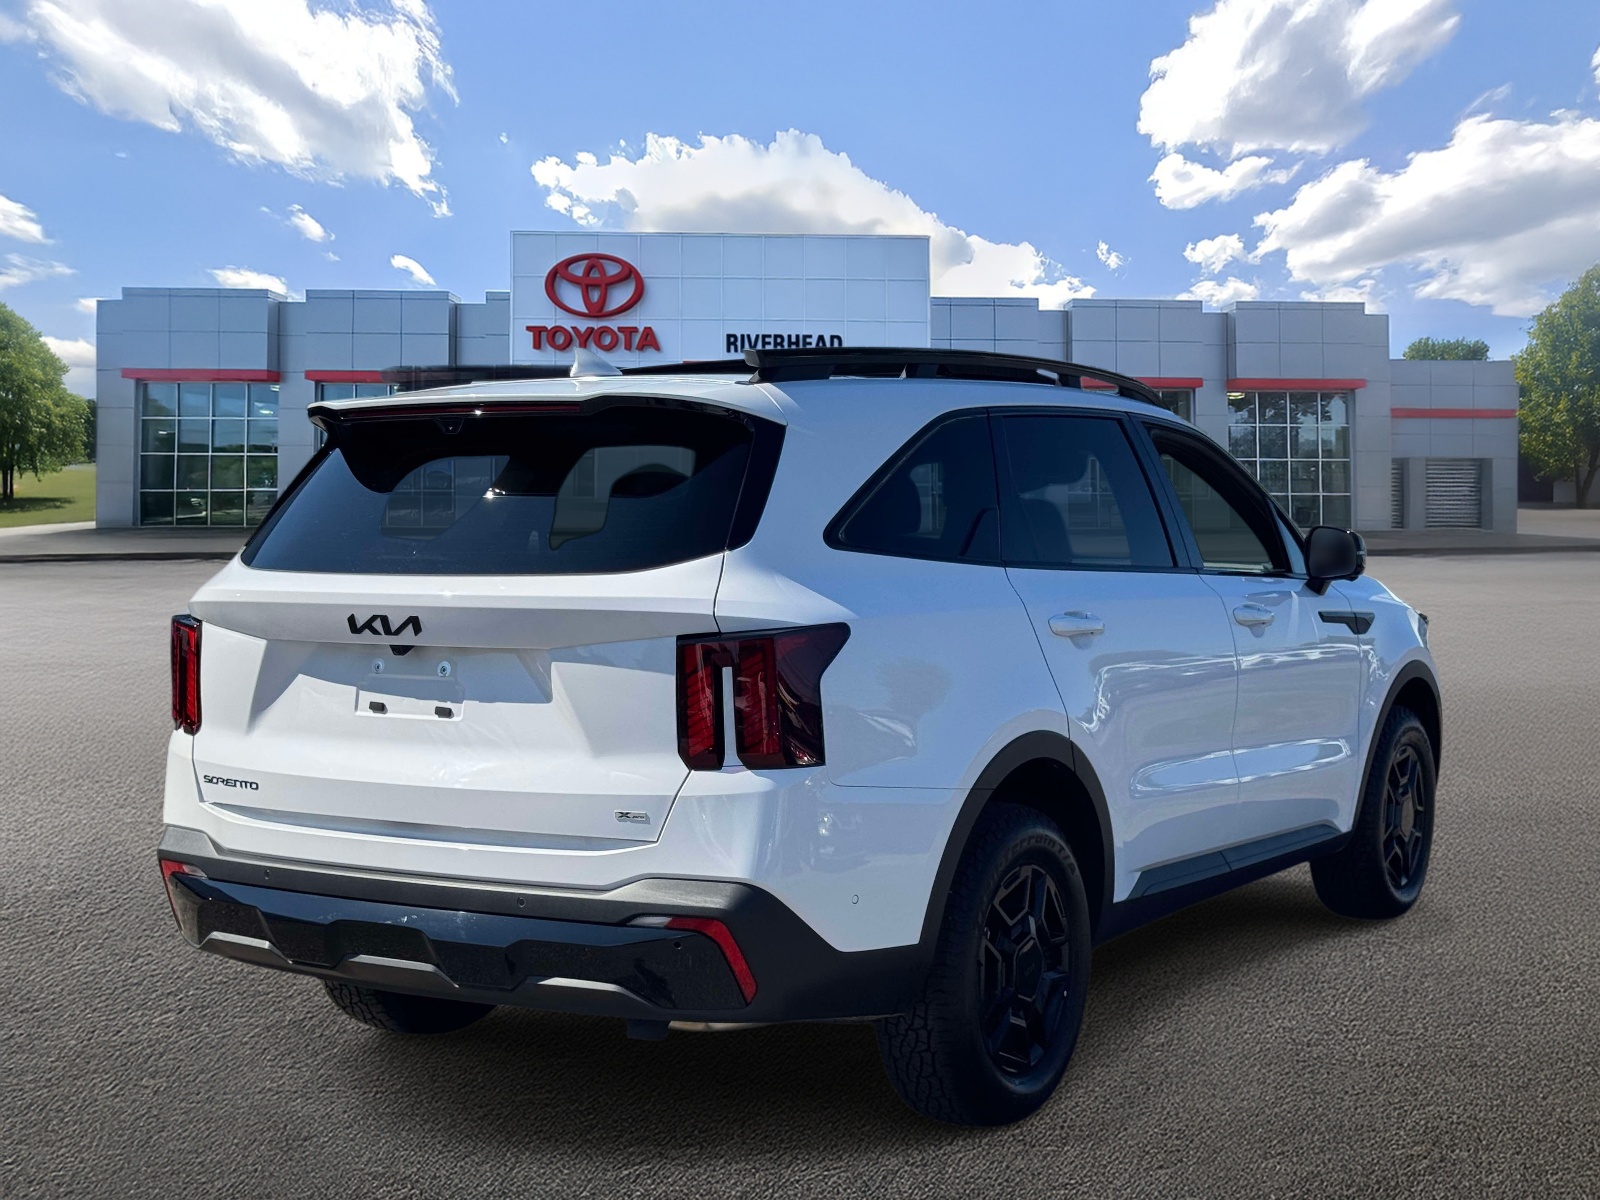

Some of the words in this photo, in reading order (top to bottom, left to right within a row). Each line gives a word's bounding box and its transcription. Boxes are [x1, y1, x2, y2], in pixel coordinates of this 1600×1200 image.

[526, 326, 661, 351] TOYOTA
[726, 334, 843, 353] RIVERHEAD
[347, 613, 422, 637] KIA
[203, 774, 259, 791] SORENTO
